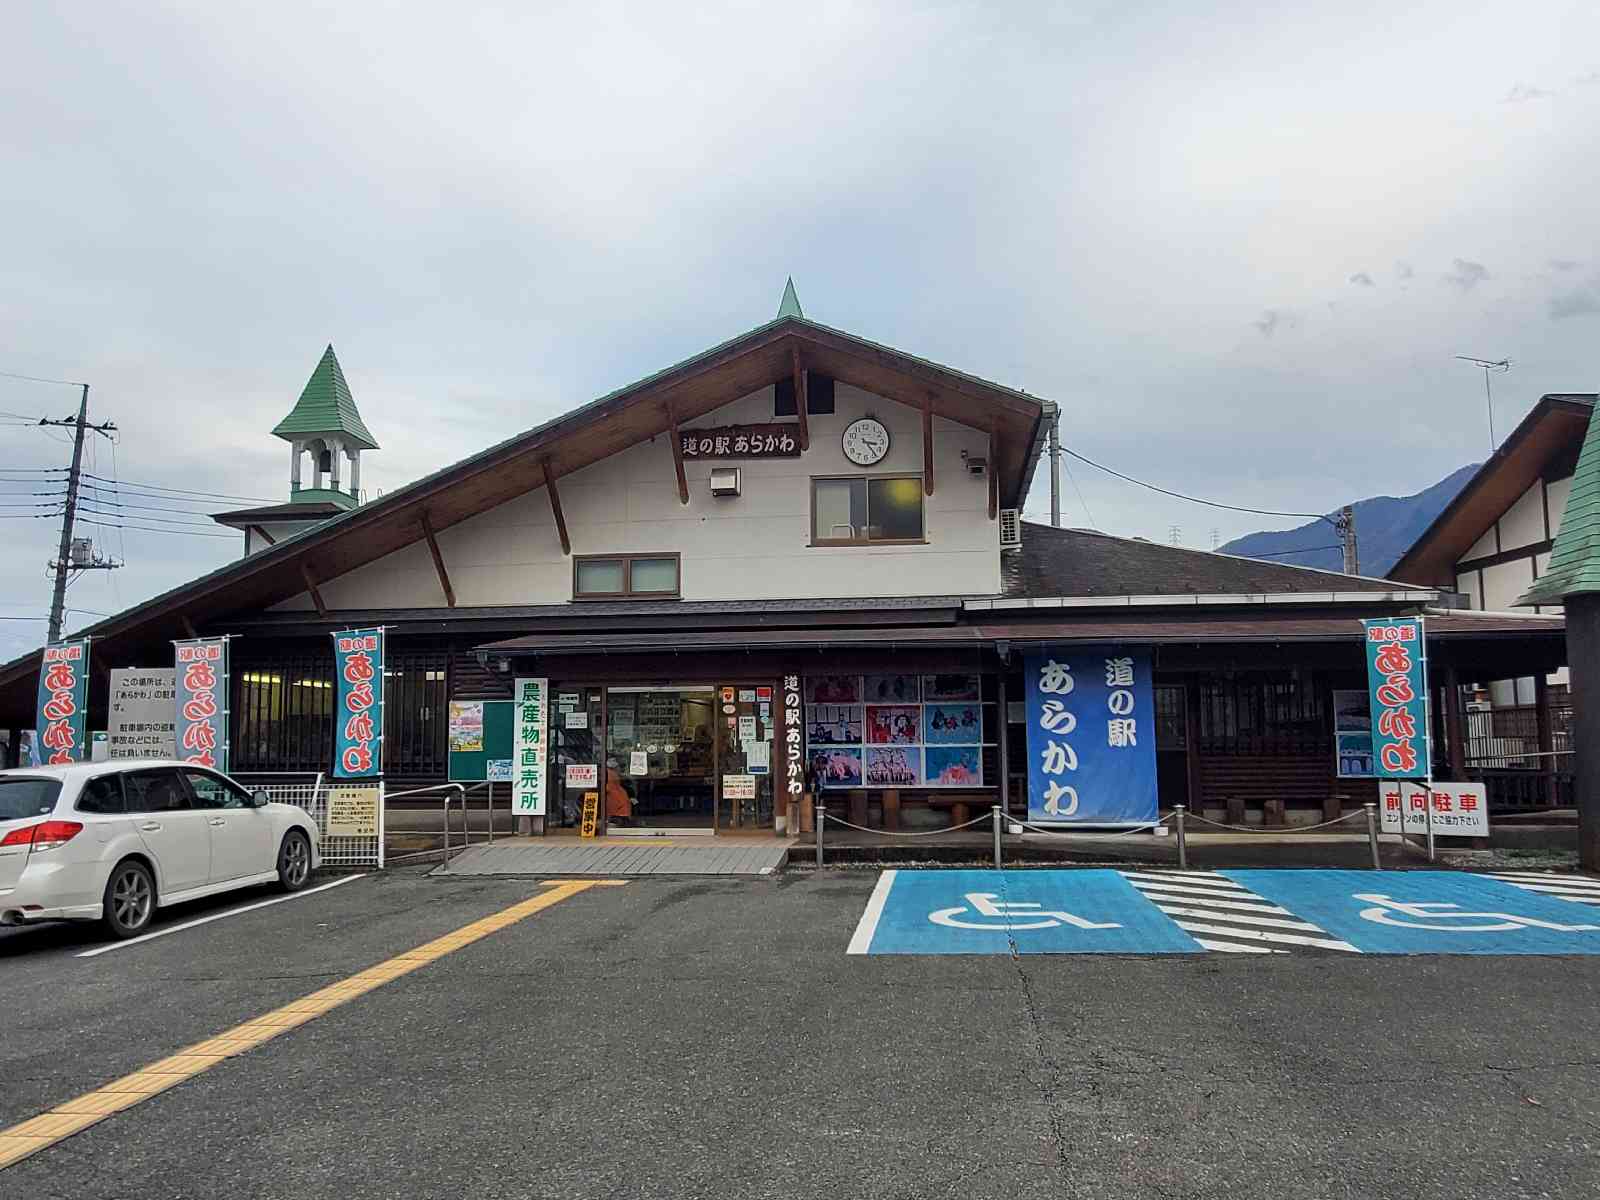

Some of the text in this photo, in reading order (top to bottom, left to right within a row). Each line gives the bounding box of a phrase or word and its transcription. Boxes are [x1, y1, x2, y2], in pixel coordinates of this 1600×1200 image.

[520, 682, 540, 810] 農産物直売所
[784, 675, 802, 794] 道の駅あらかわ
[1039, 659, 1078, 816] あらかわ
[1105, 657, 1137, 747] 道の駅
[584, 798, 596, 834] 営業中
[1385, 792, 1478, 813] 前向駐車
[1386, 814, 1480, 826] エンンの停にご協力下さい
